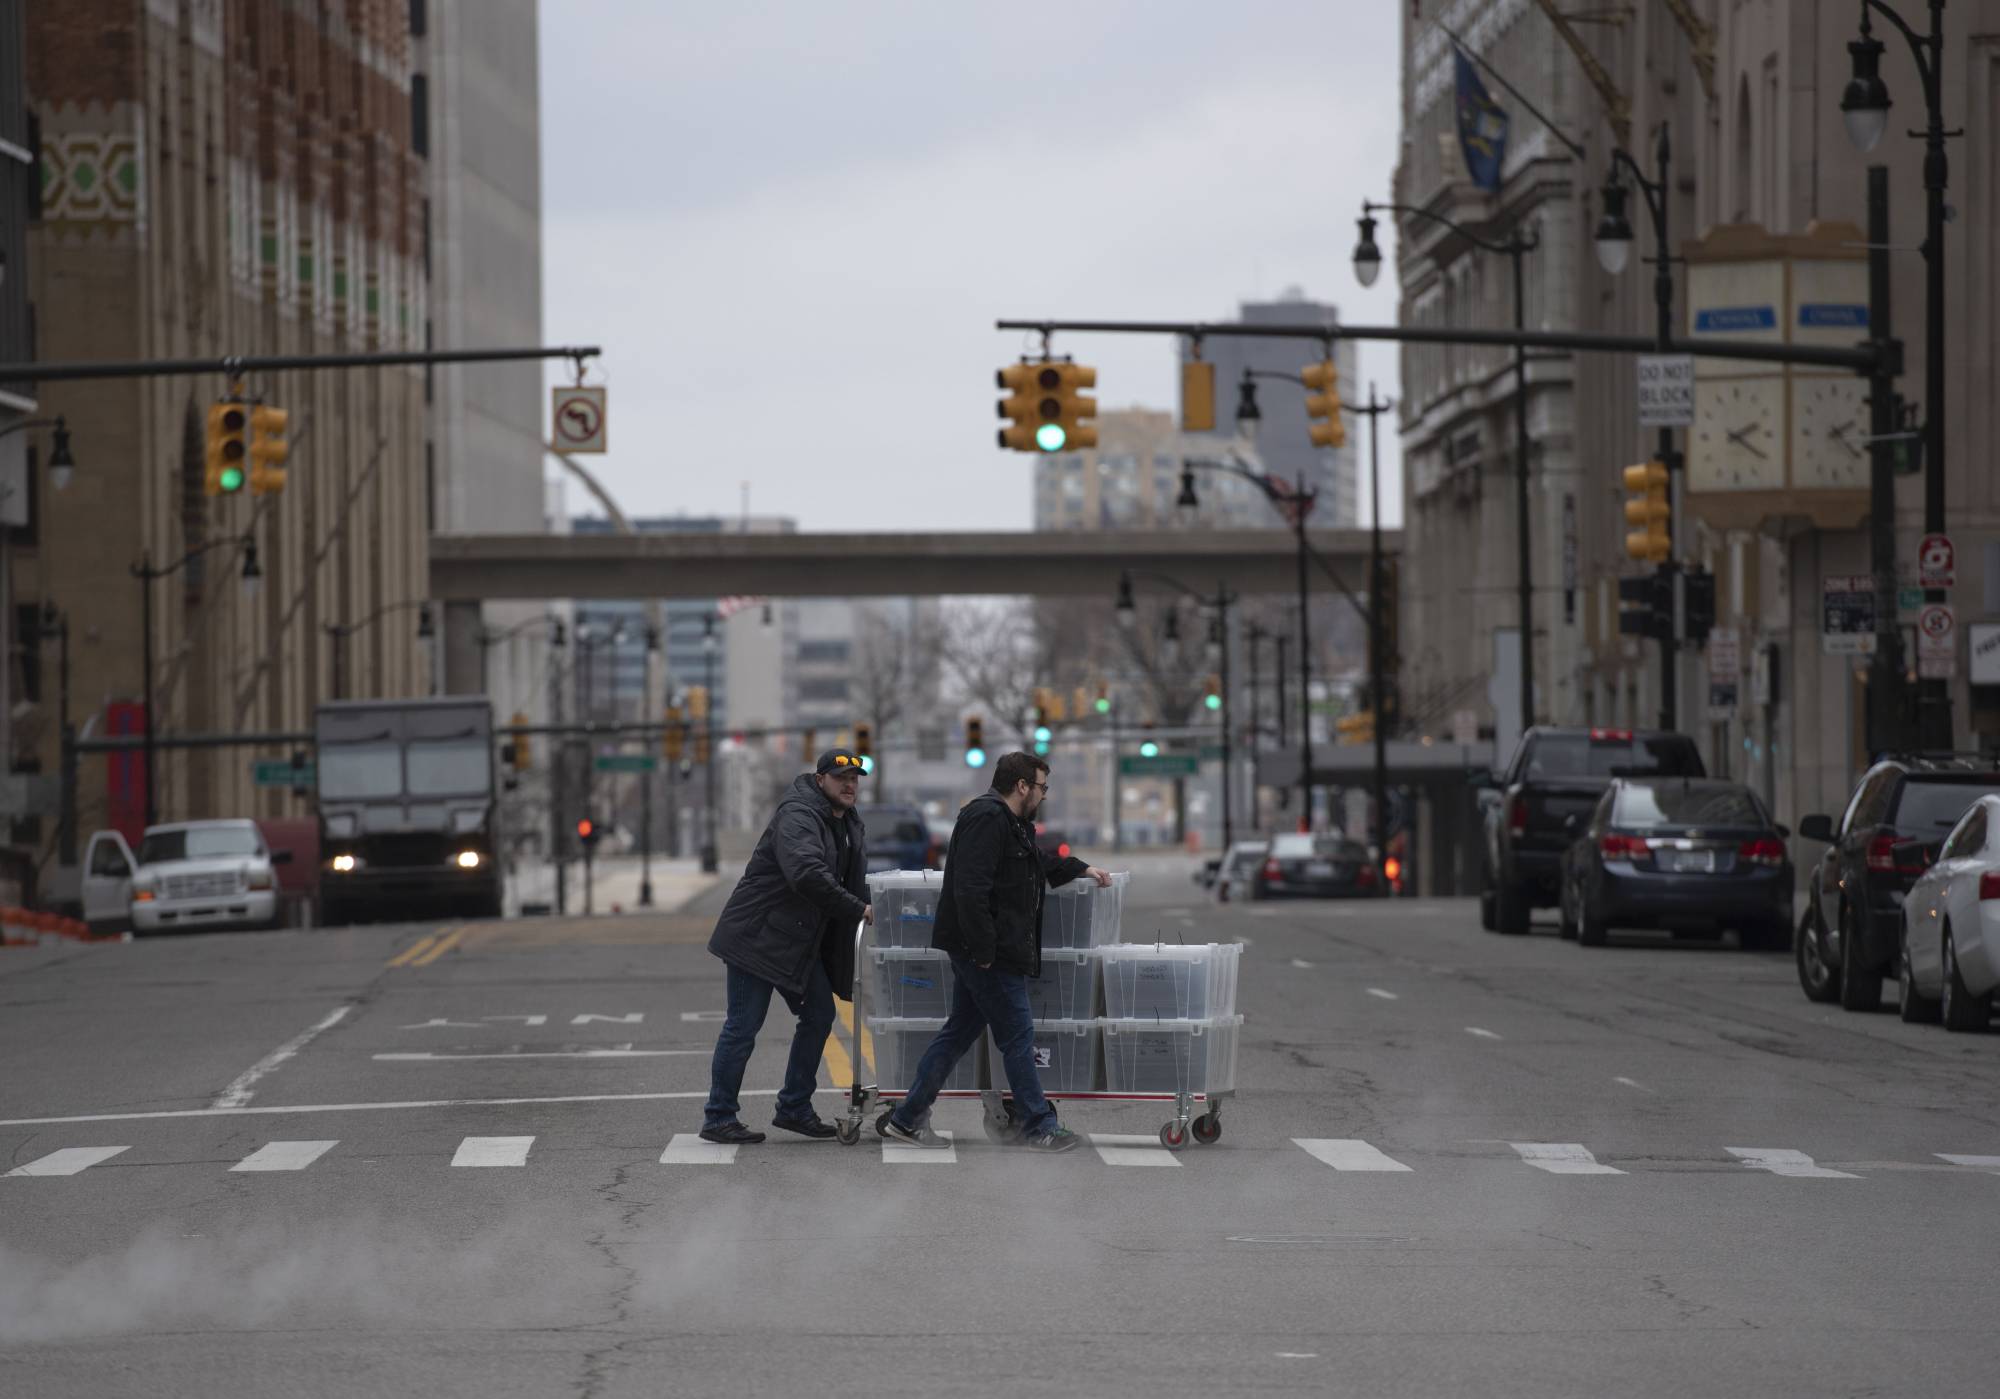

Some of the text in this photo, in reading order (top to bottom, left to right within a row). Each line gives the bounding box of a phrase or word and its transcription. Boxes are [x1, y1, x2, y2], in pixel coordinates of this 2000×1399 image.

[1640, 364, 1690, 381] DO NOT
[1640, 387, 1691, 403] BLOCK
